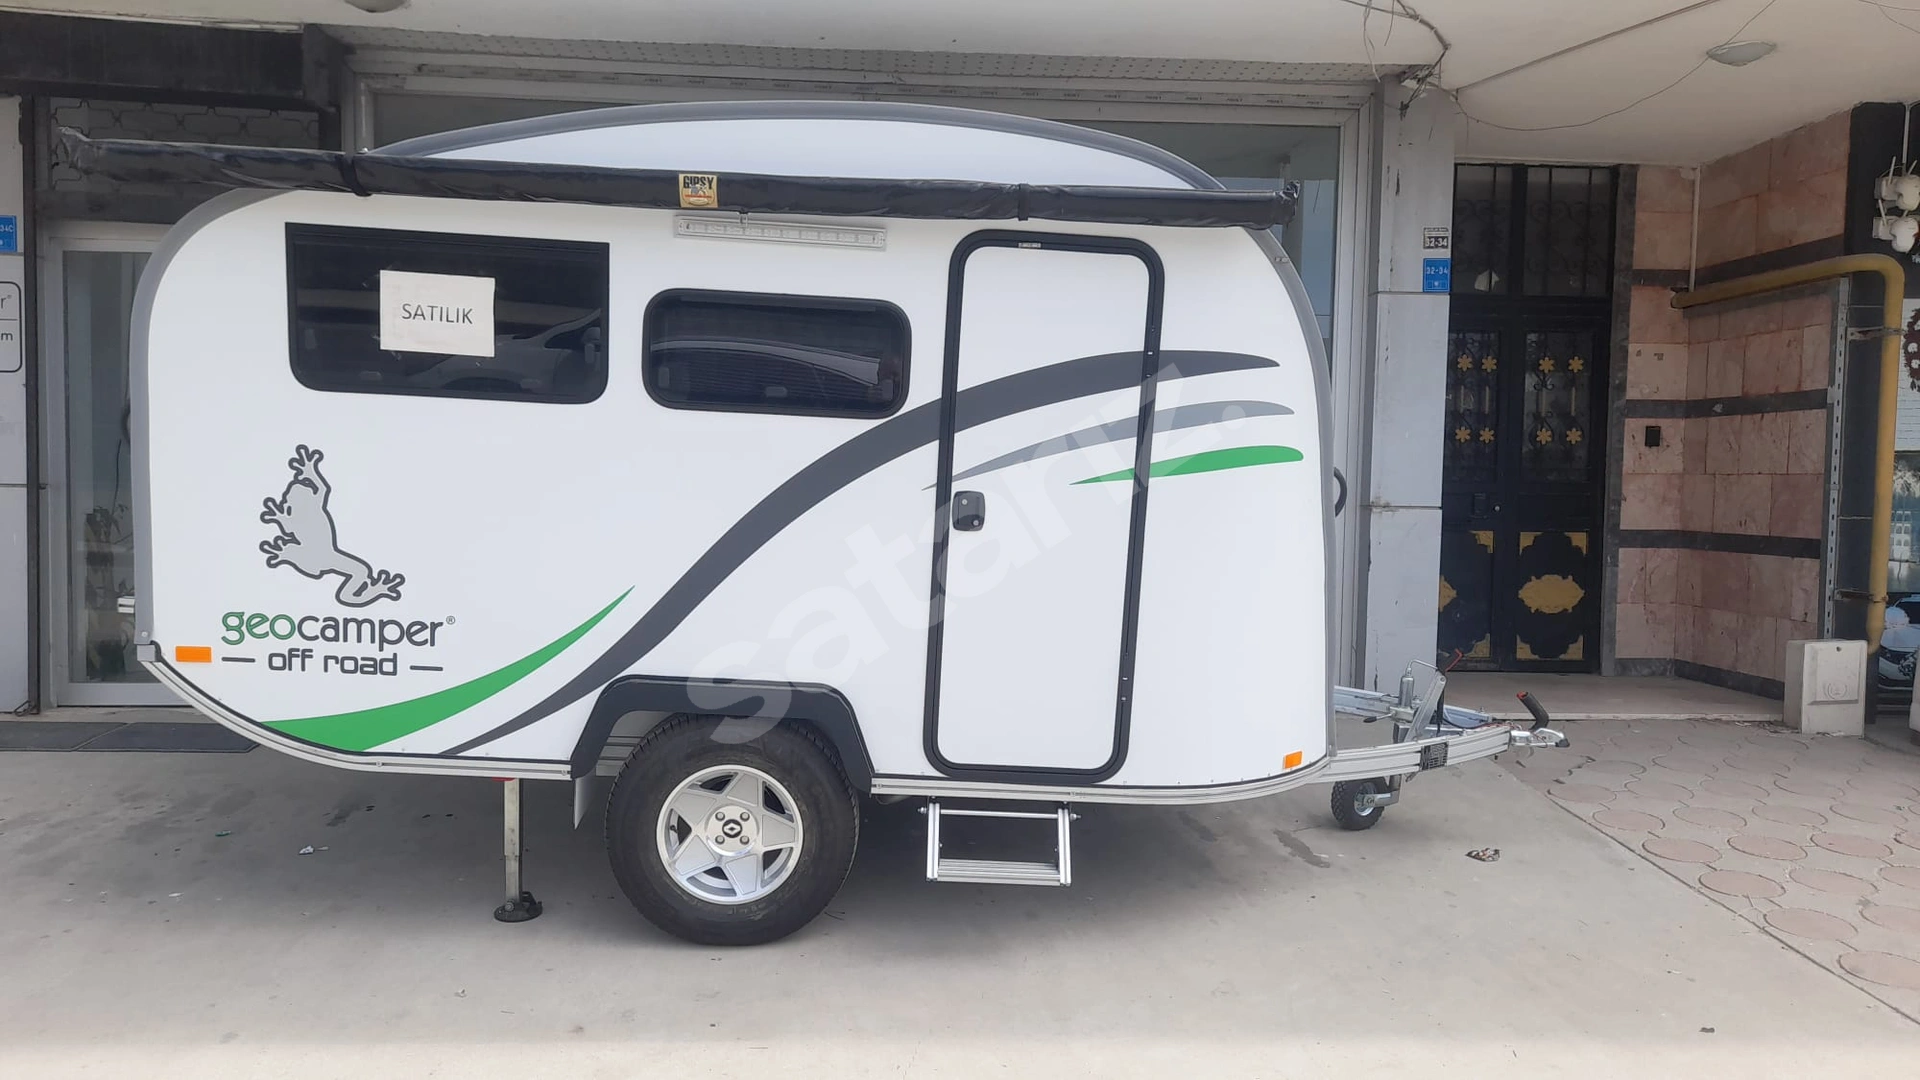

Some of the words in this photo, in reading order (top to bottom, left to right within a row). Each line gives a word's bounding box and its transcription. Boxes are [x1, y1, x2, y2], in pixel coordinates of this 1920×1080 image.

[683, 175, 714, 190] GIPSY
[401, 303, 473, 325] SATILIK
[268, 647, 314, 672] off
[323, 652, 398, 677] road
